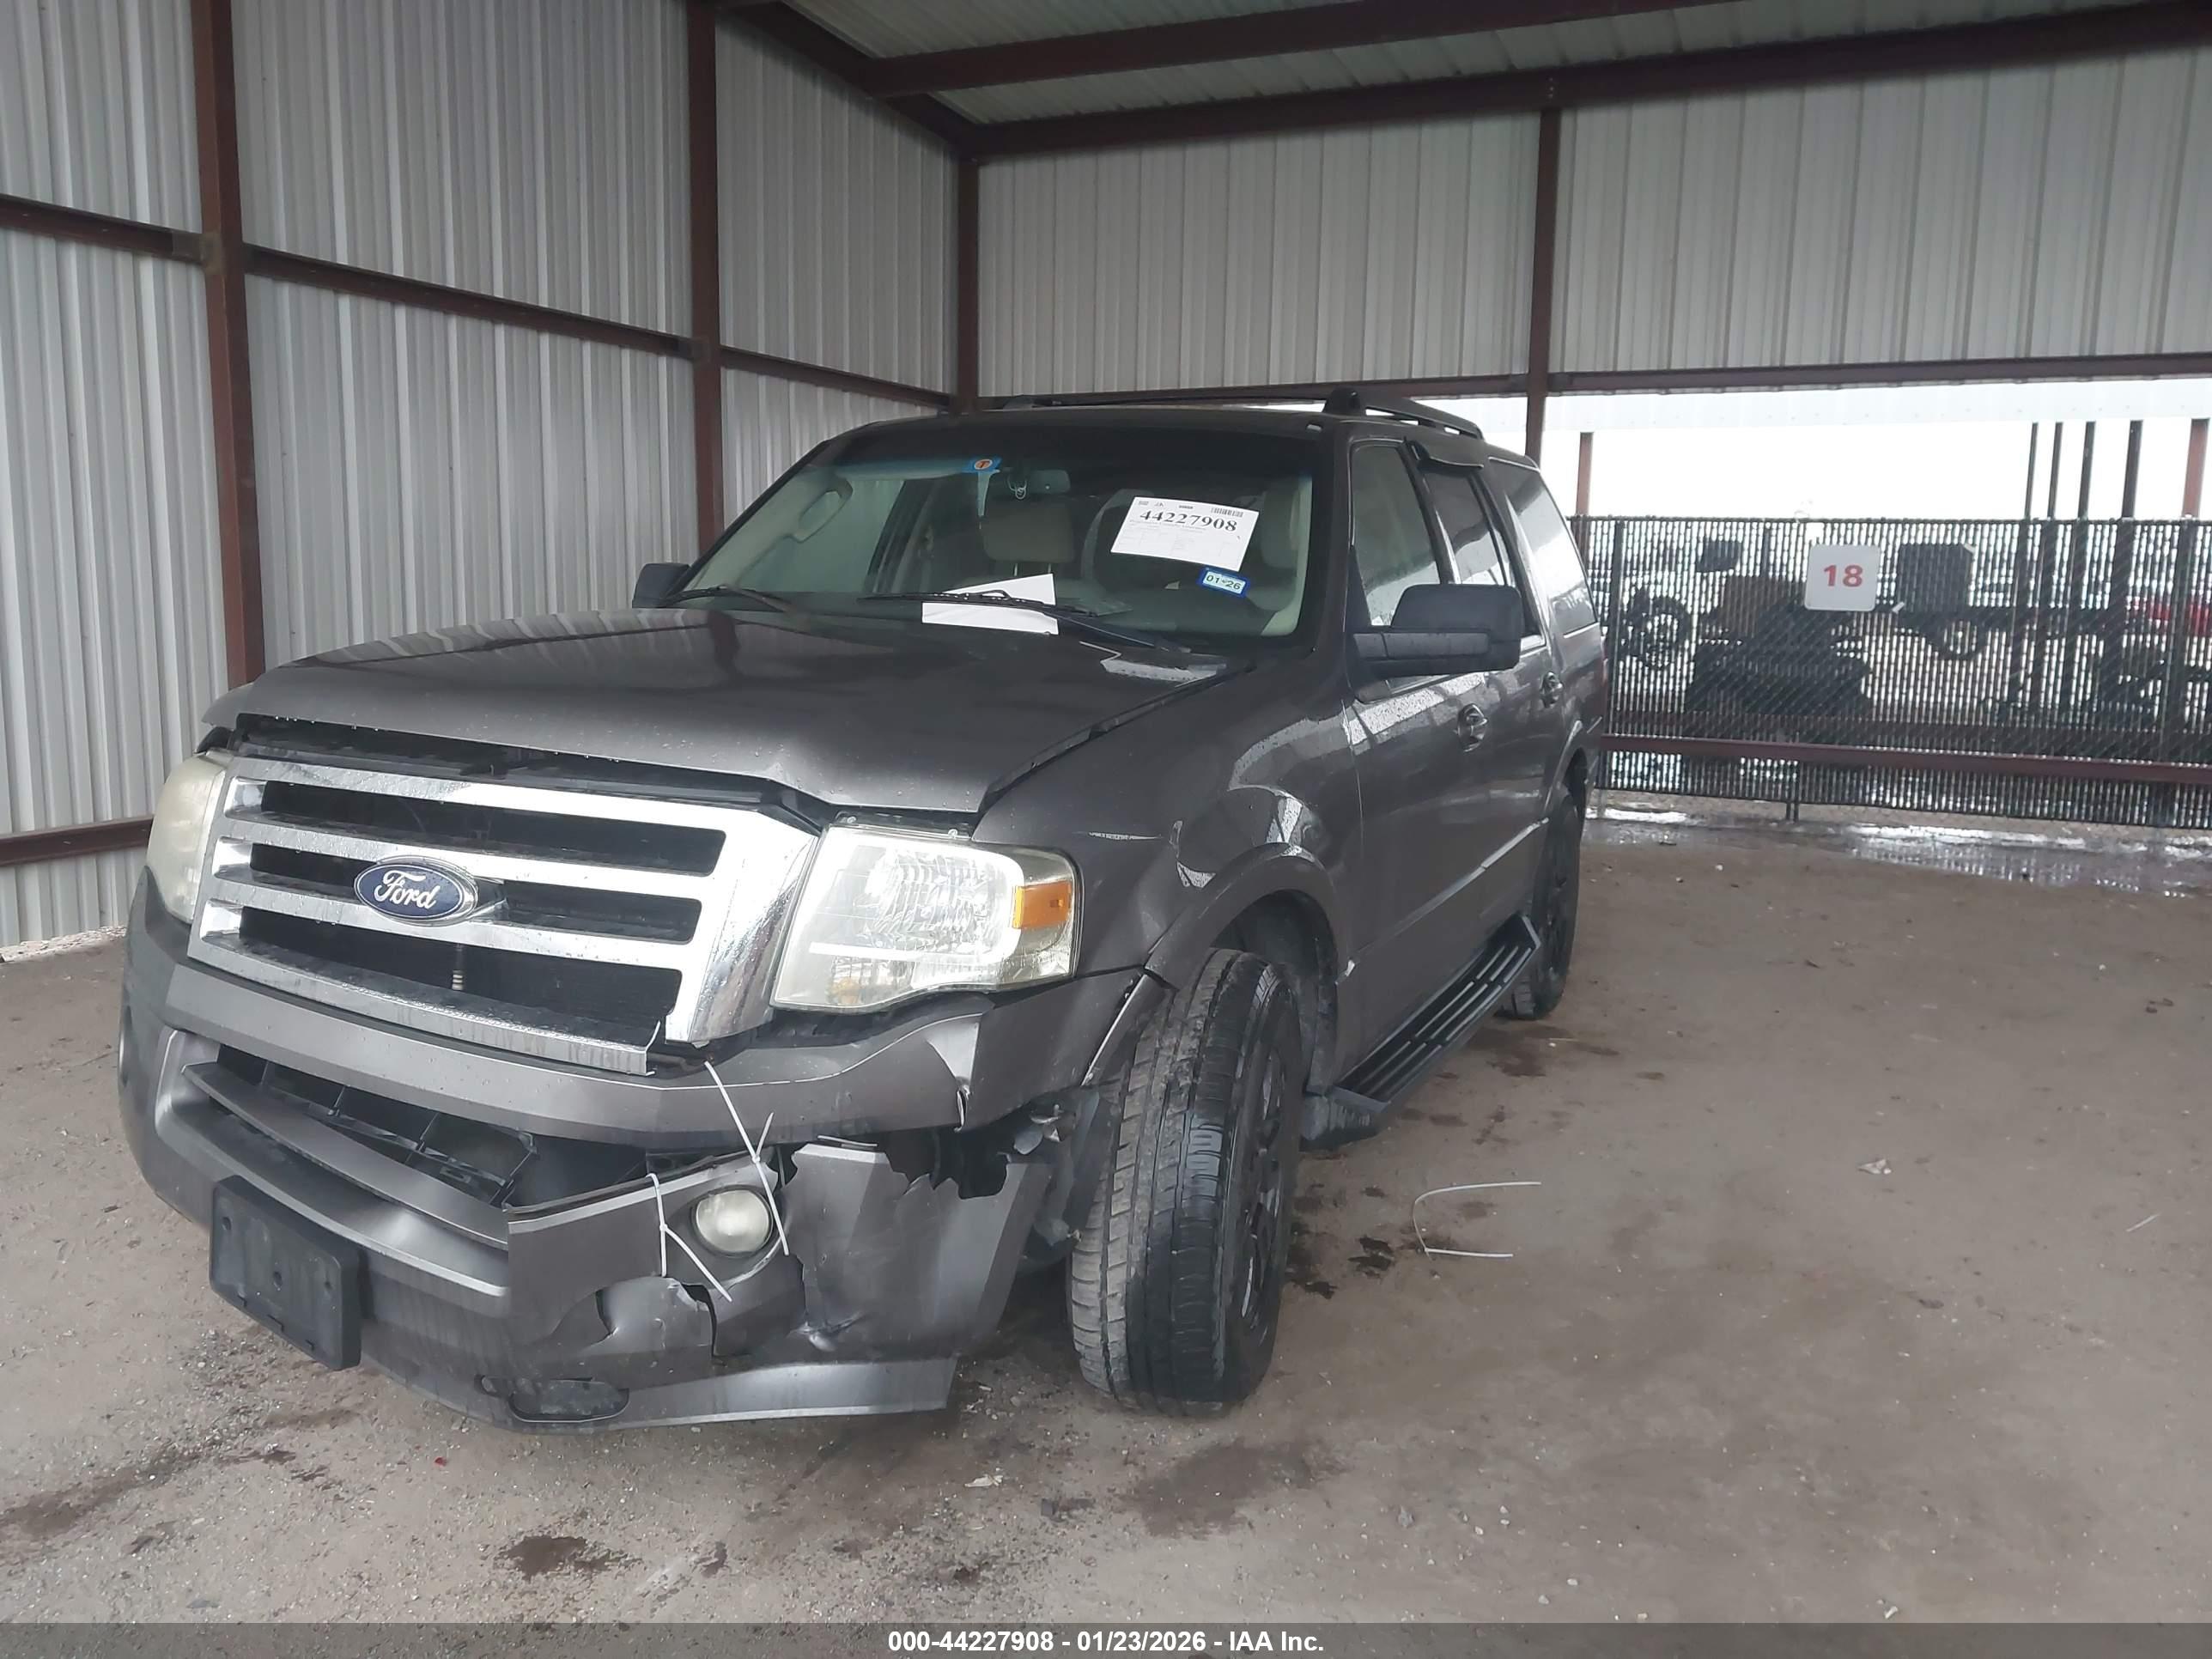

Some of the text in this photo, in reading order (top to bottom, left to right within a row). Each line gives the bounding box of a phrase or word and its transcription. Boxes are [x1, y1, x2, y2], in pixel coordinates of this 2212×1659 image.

[1139, 510, 1237, 532] 44227908
[1823, 564, 1863, 587] 18
[374, 870, 441, 909] Ford
